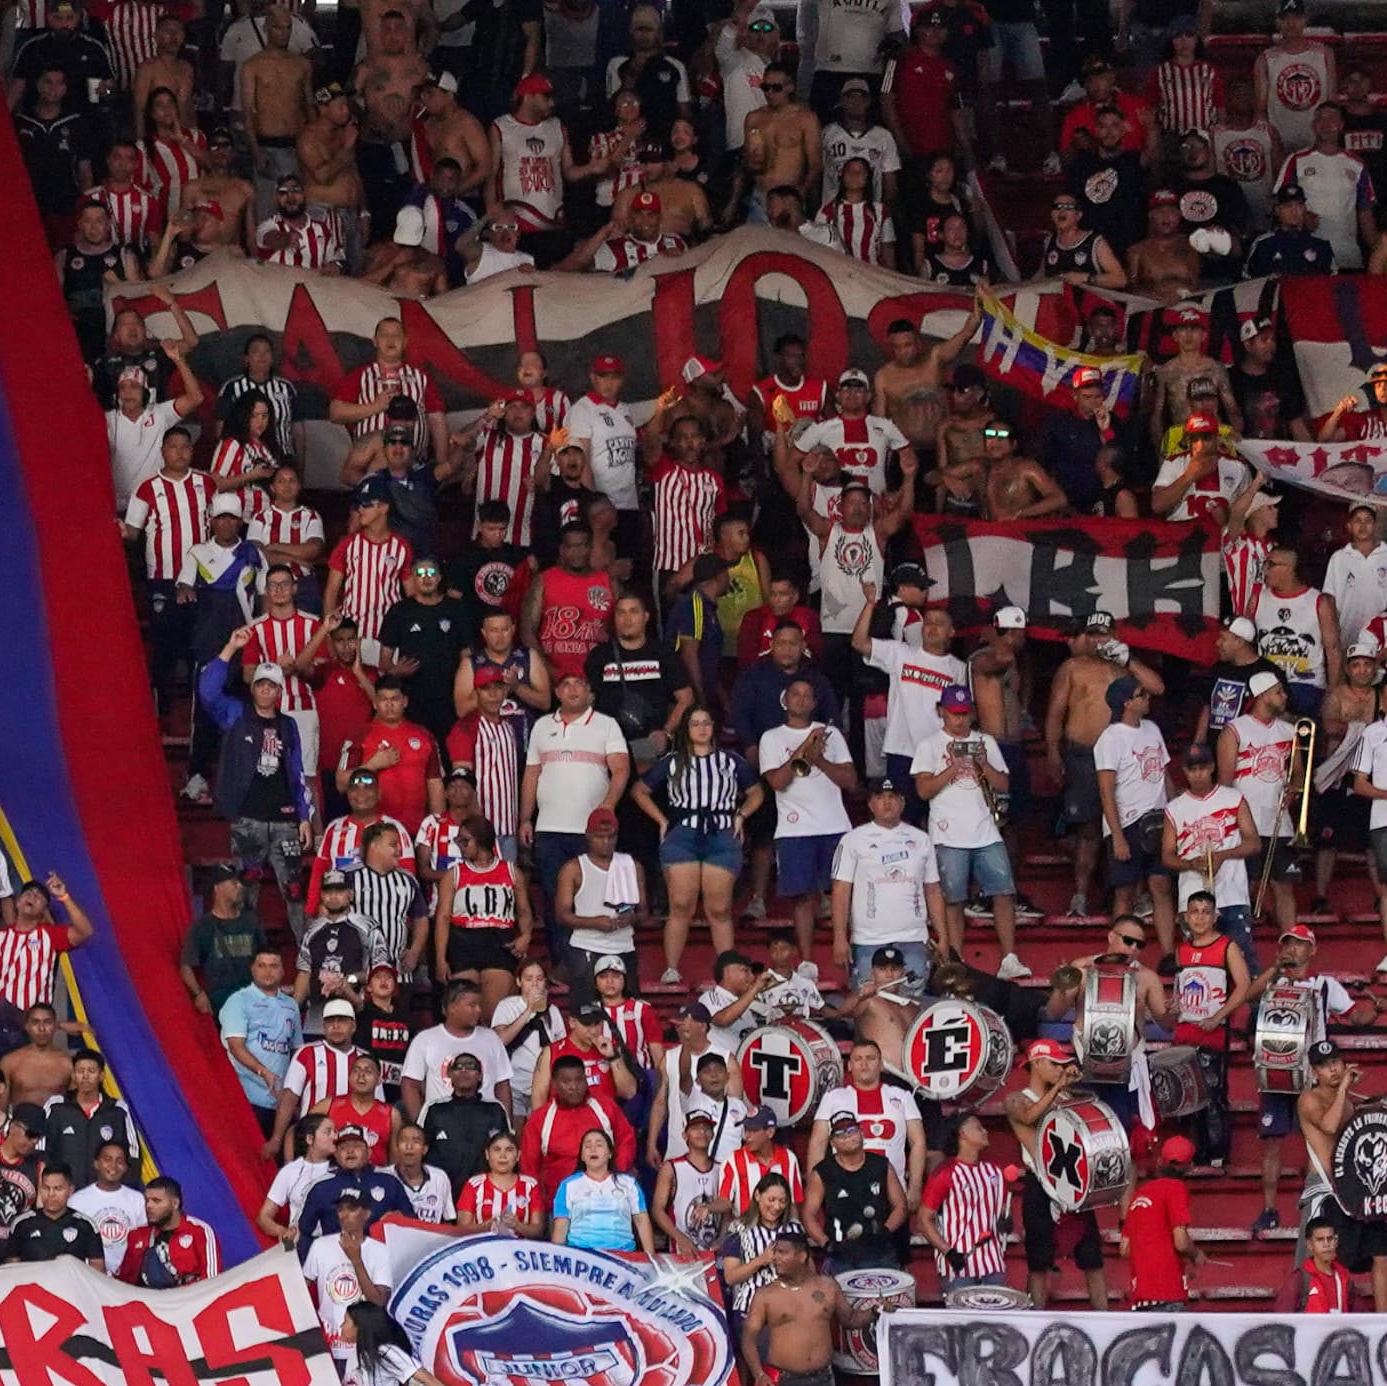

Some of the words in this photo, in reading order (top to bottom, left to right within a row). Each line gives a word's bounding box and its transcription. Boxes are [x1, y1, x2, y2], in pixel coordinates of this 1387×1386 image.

[752, 1051, 801, 1100] T
[1045, 1126, 1083, 1189] X
[443, 1257, 496, 1293] 1998
[514, 1249, 621, 1294] SIEMPRE
[499, 1359, 599, 1381] JUNIOR
